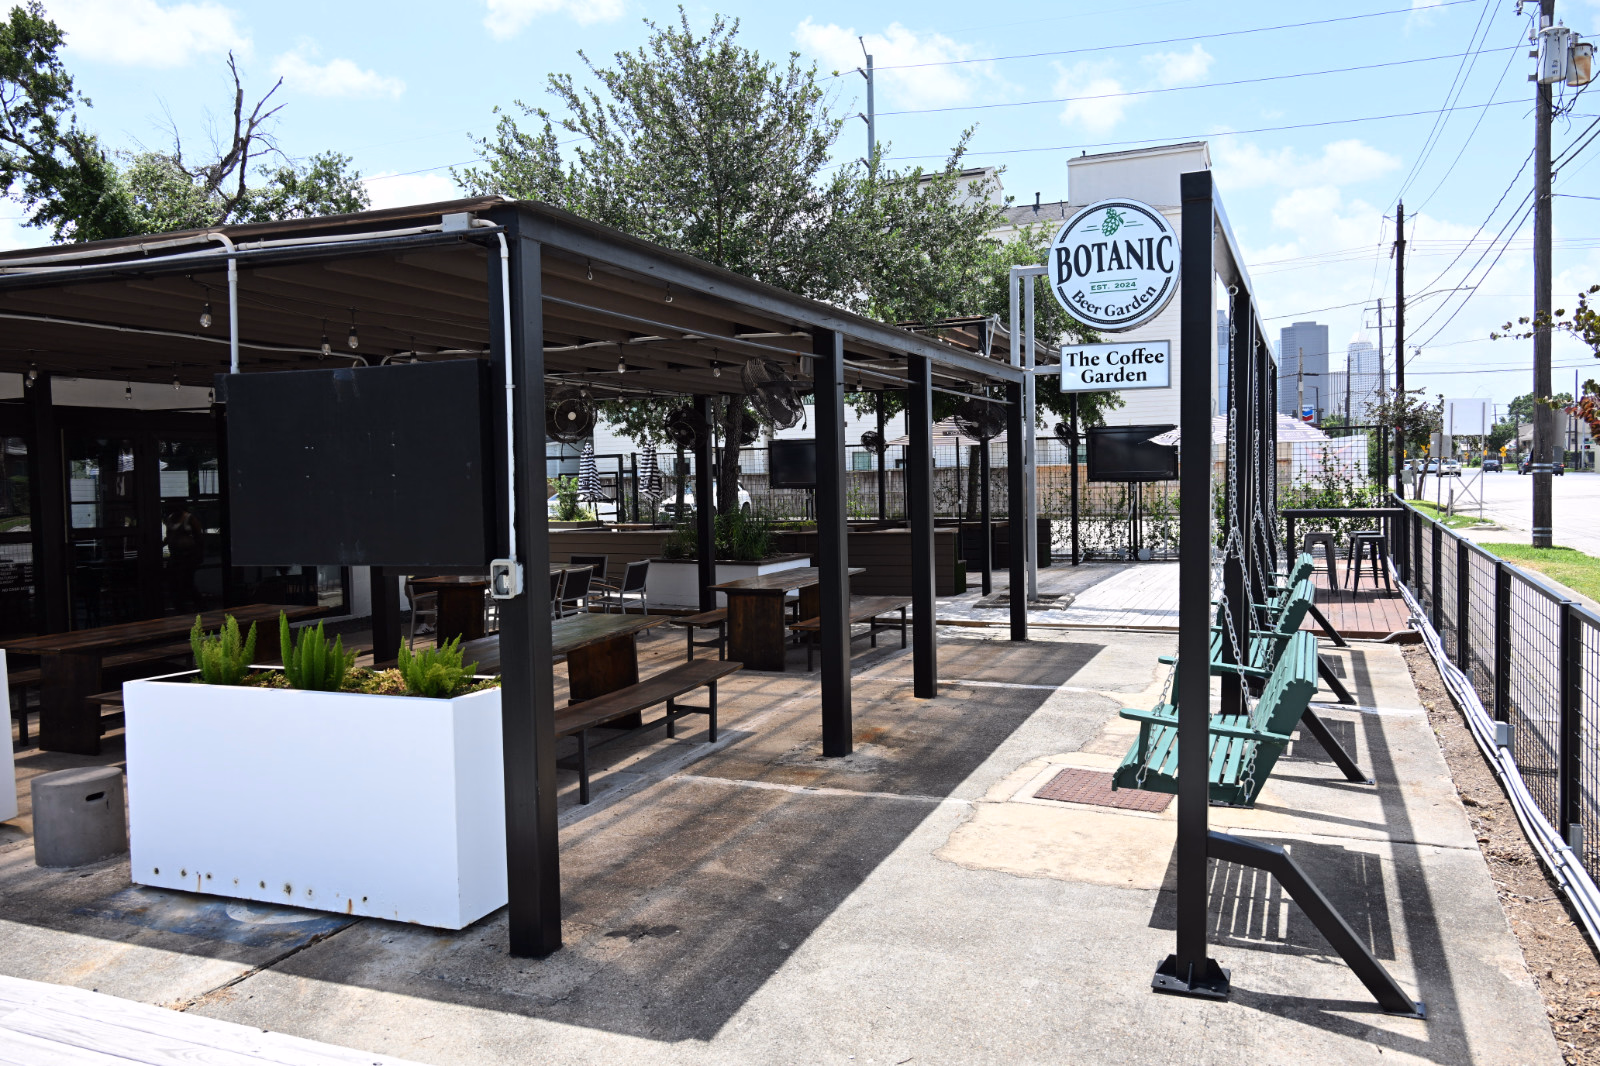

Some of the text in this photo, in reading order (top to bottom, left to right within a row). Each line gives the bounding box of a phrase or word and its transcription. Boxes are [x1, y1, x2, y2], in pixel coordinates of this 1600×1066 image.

[1055, 235, 1174, 286] BOTANIC
[1090, 281, 1137, 291] EST. 2024
[1071, 285, 1157, 317] Beer Garden
[1066, 347, 1165, 367] The Coffee
[1080, 366, 1147, 384] Garden
